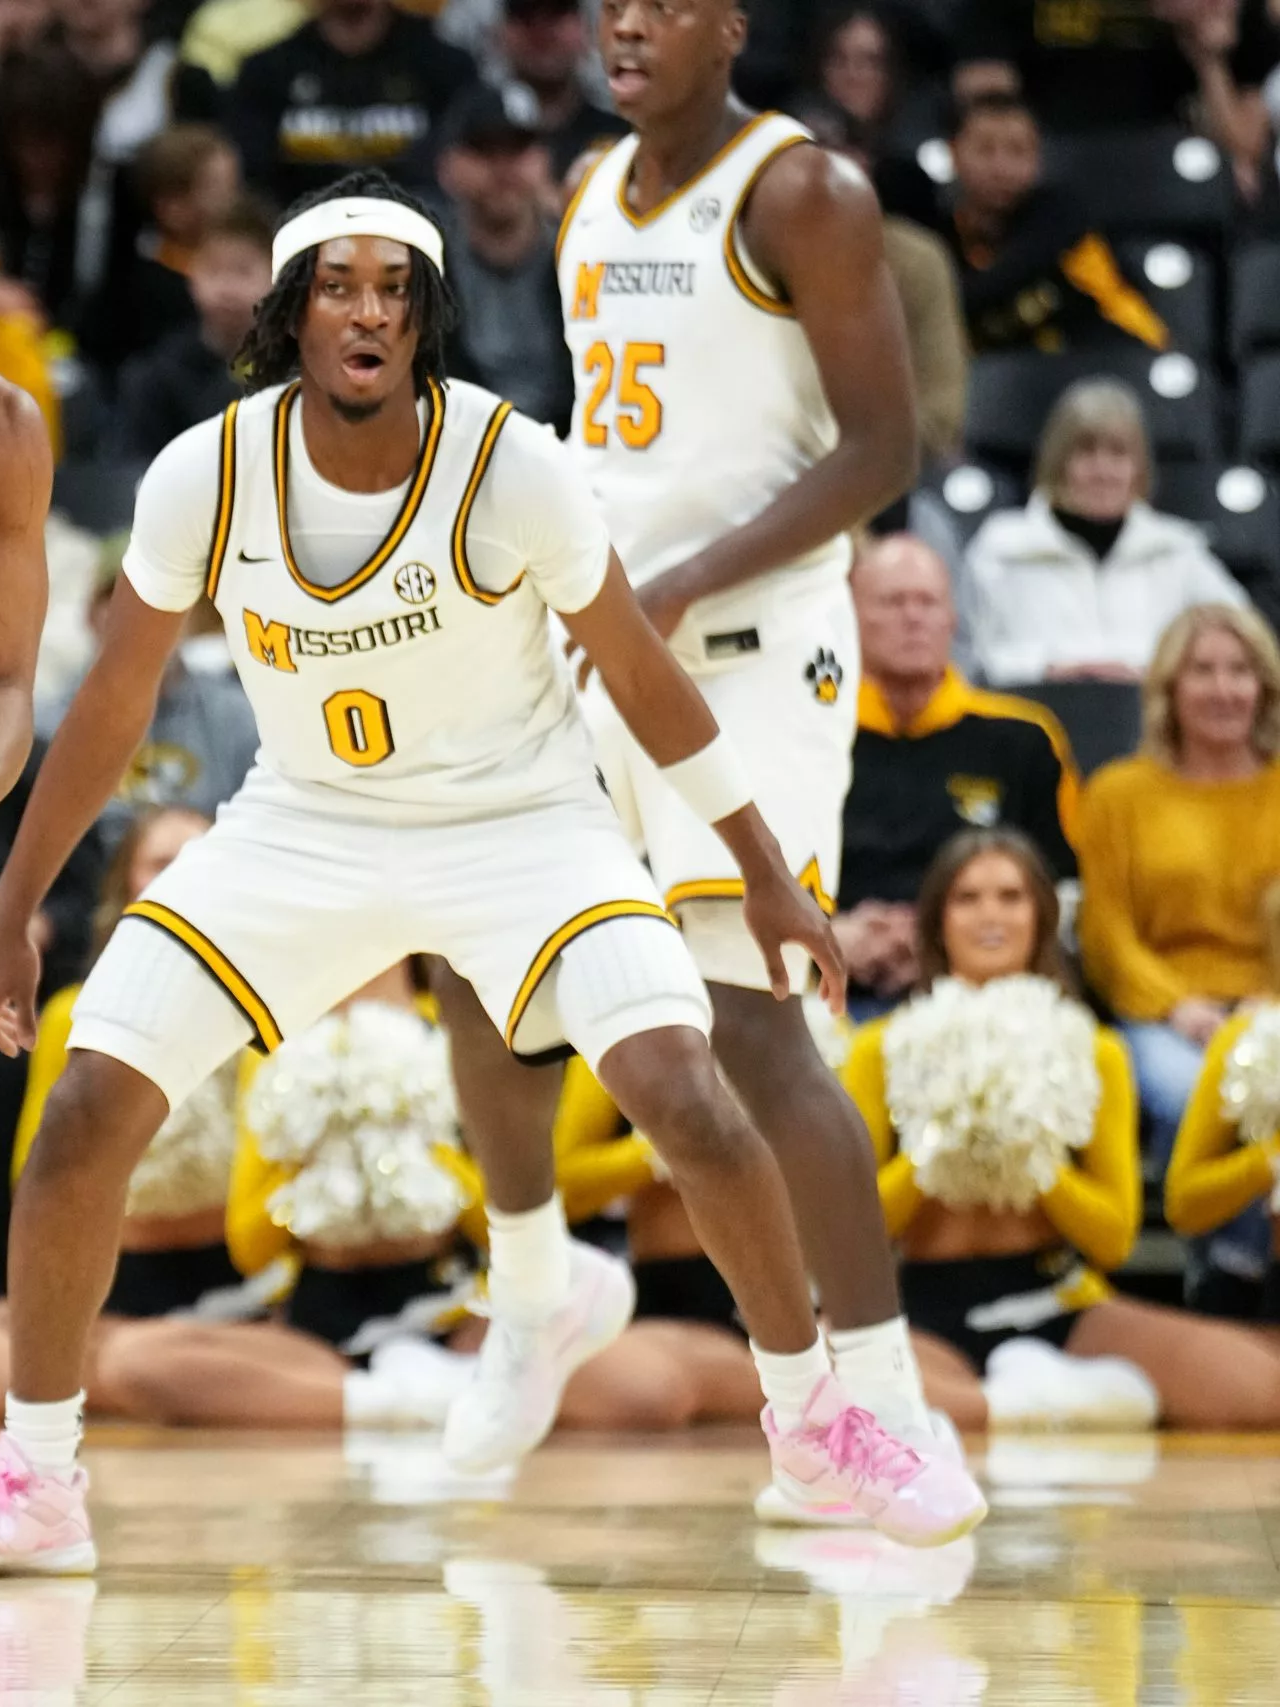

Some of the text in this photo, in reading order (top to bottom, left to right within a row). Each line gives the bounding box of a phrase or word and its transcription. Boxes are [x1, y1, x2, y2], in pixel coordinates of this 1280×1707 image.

[570, 260, 696, 320] MISSOURI
[583, 340, 665, 451] 25
[395, 563, 435, 603] SEC
[242, 606, 444, 675] MISSOURI
[321, 688, 397, 769] 0
